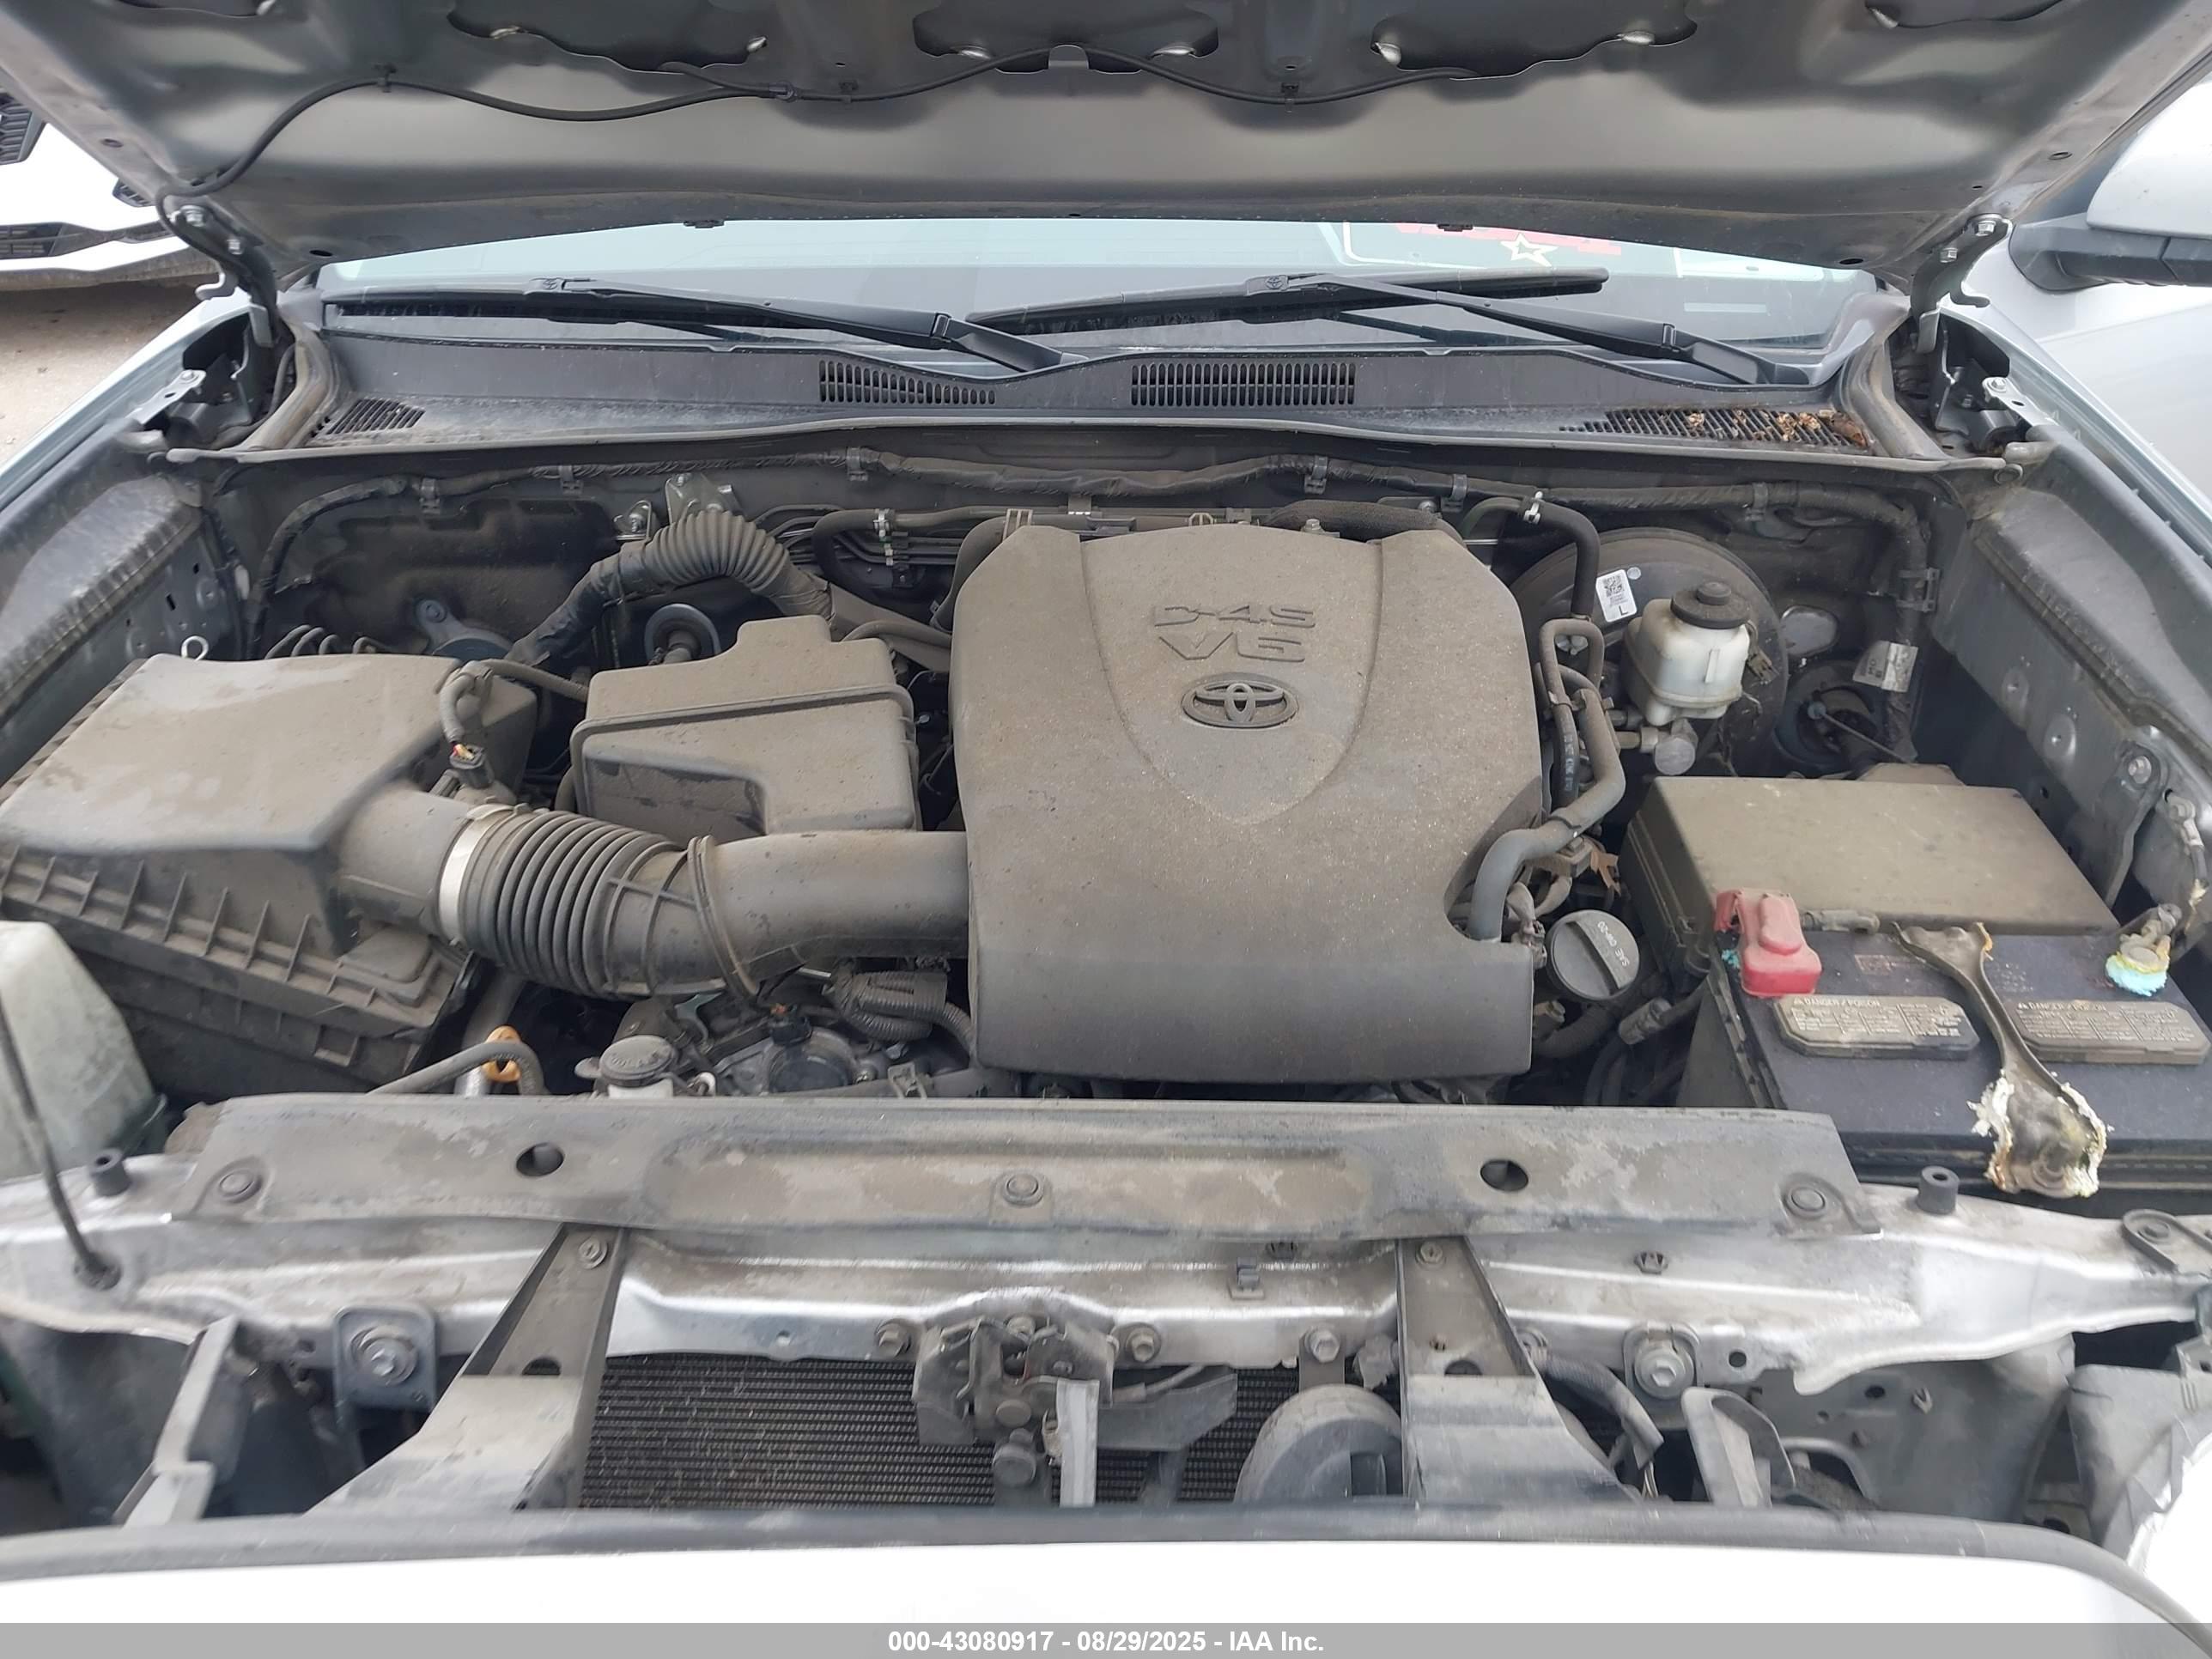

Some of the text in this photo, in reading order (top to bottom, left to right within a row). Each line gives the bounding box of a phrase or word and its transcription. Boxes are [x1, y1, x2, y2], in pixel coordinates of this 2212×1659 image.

[1158, 631, 1305, 663] V6
[1598, 921, 1630, 966] SAE 0W-20
